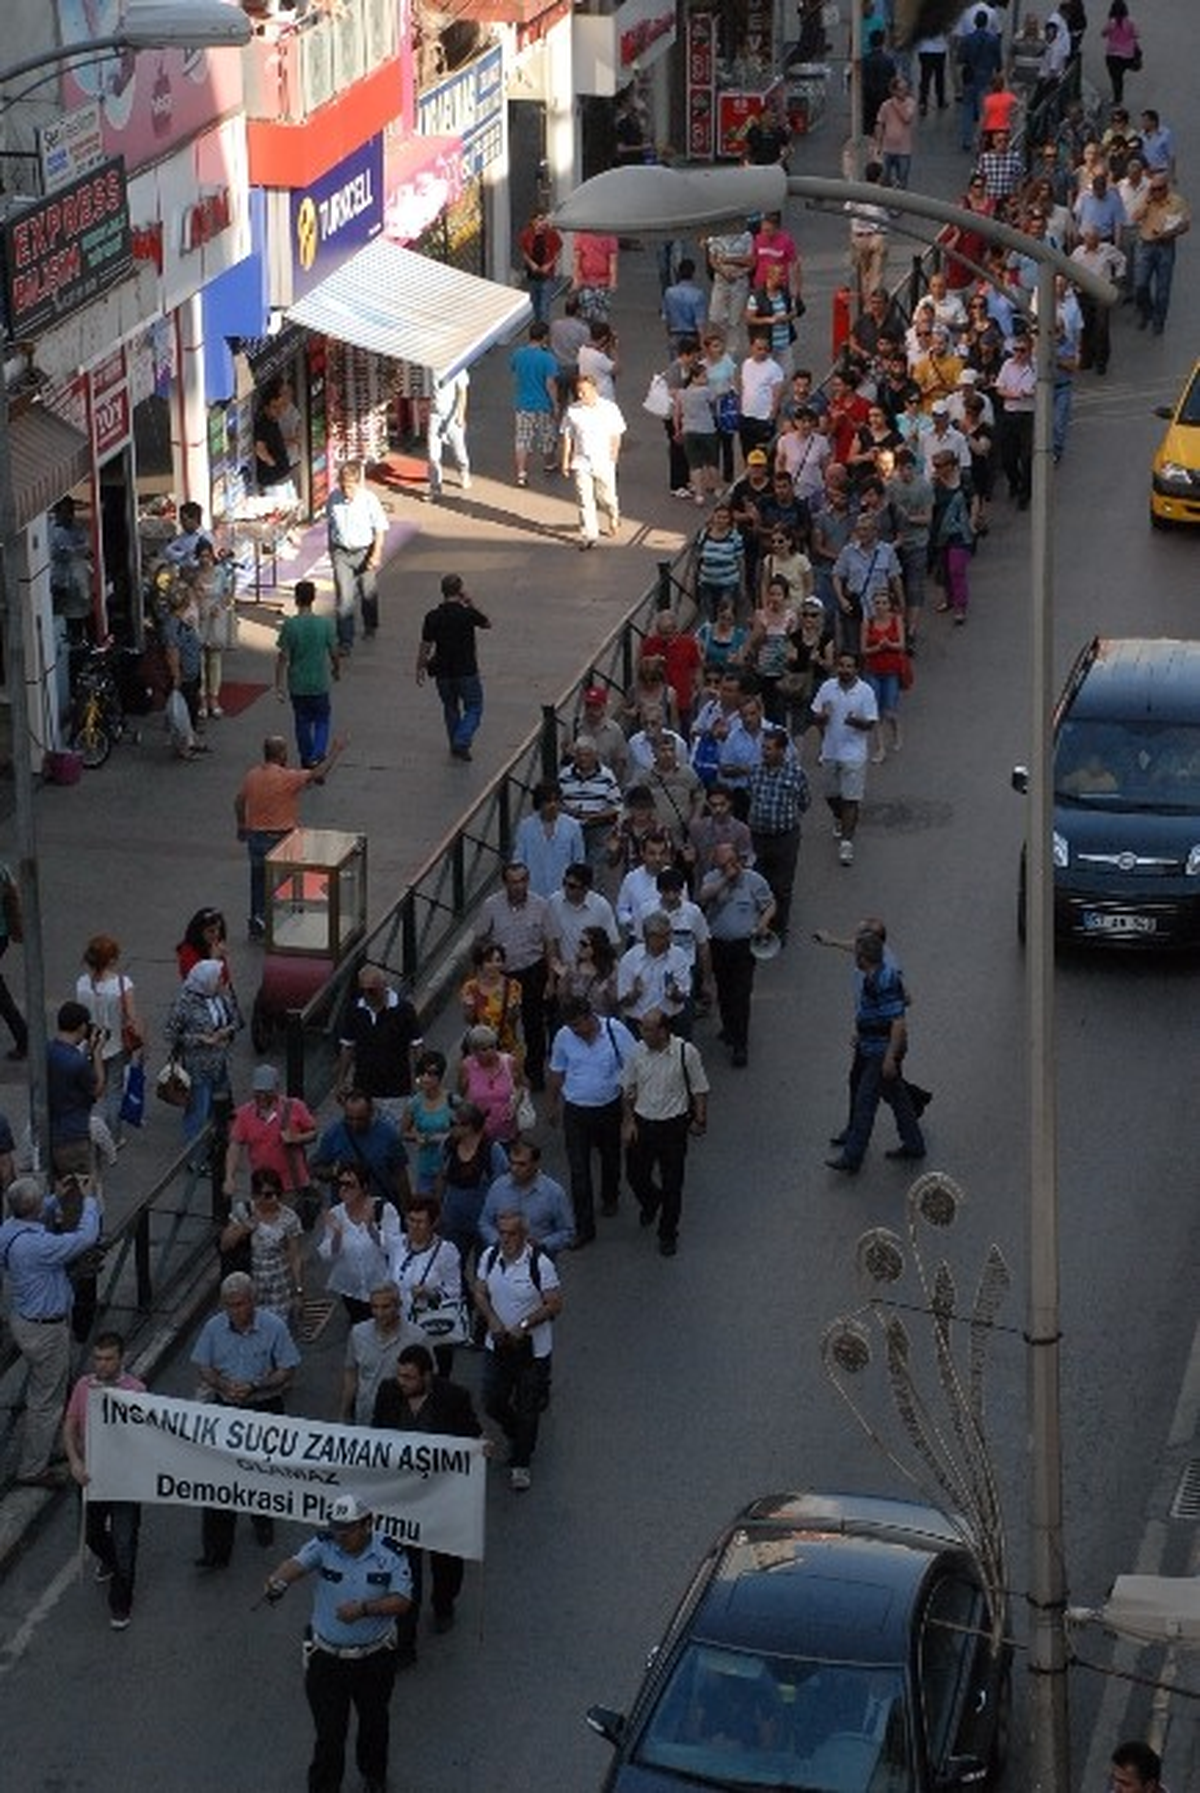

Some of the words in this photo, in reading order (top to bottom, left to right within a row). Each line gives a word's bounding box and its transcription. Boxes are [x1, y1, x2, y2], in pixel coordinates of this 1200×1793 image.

[13, 170, 122, 268] EXPRESS
[319, 168, 374, 241] TURKCELL
[102, 1396, 223, 1447] İNSANLIK
[226, 1419, 299, 1463] SUÇU
[303, 1432, 391, 1469] ZAMAN
[398, 1443, 472, 1481] AŞIMI
[156, 1472, 295, 1515] Demokrasi
[302, 1492, 421, 1543] Plarmu
